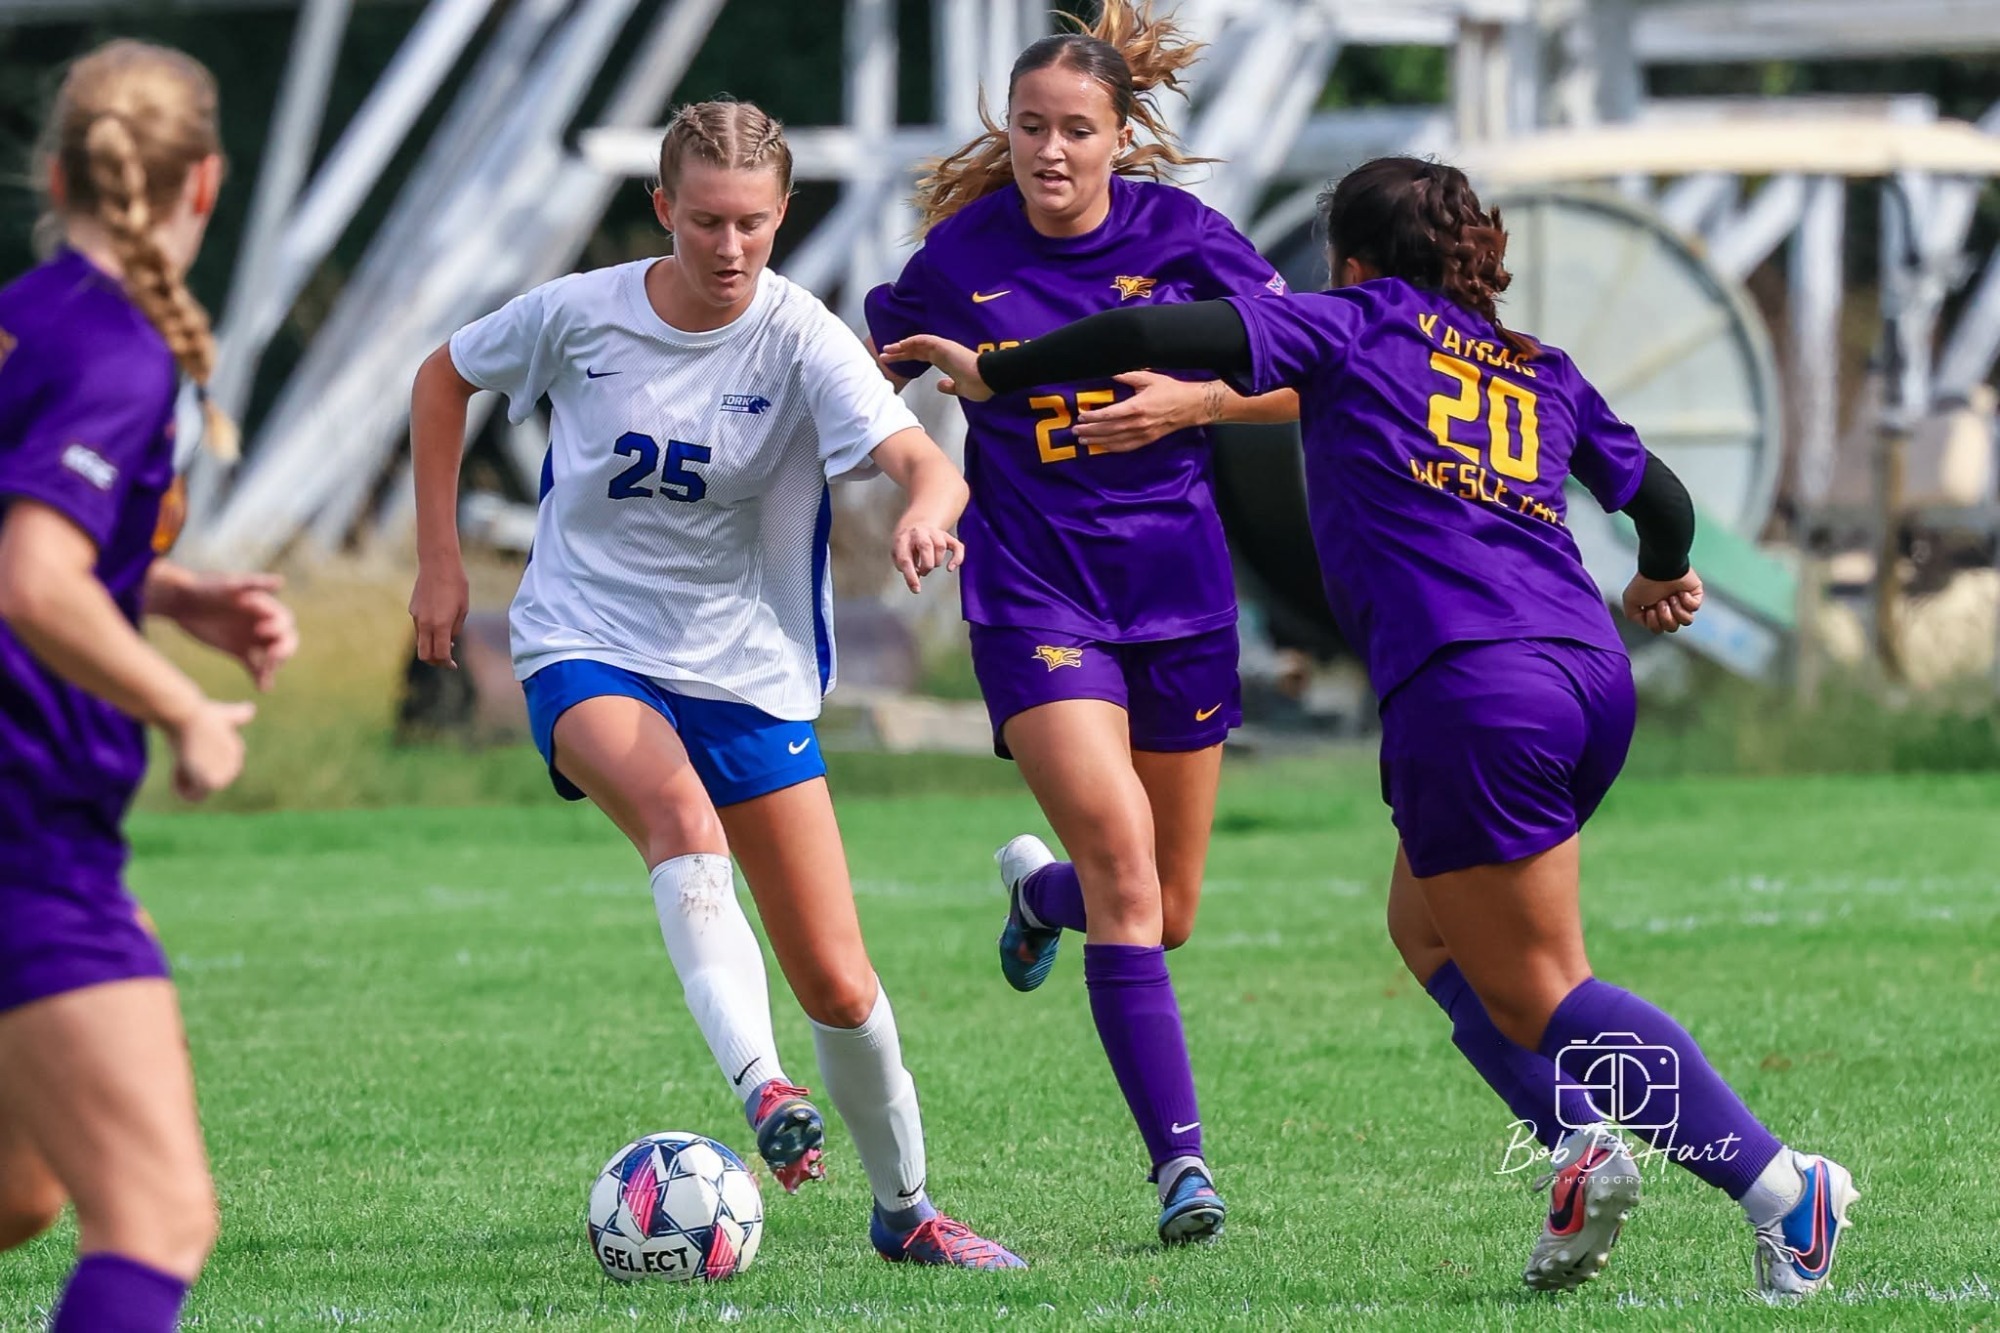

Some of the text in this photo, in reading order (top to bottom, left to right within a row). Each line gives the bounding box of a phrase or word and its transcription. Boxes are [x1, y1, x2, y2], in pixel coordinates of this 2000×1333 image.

[1428, 351, 1540, 483] 20
[608, 431, 712, 503] 25
[604, 1245, 689, 1273] SELECT
